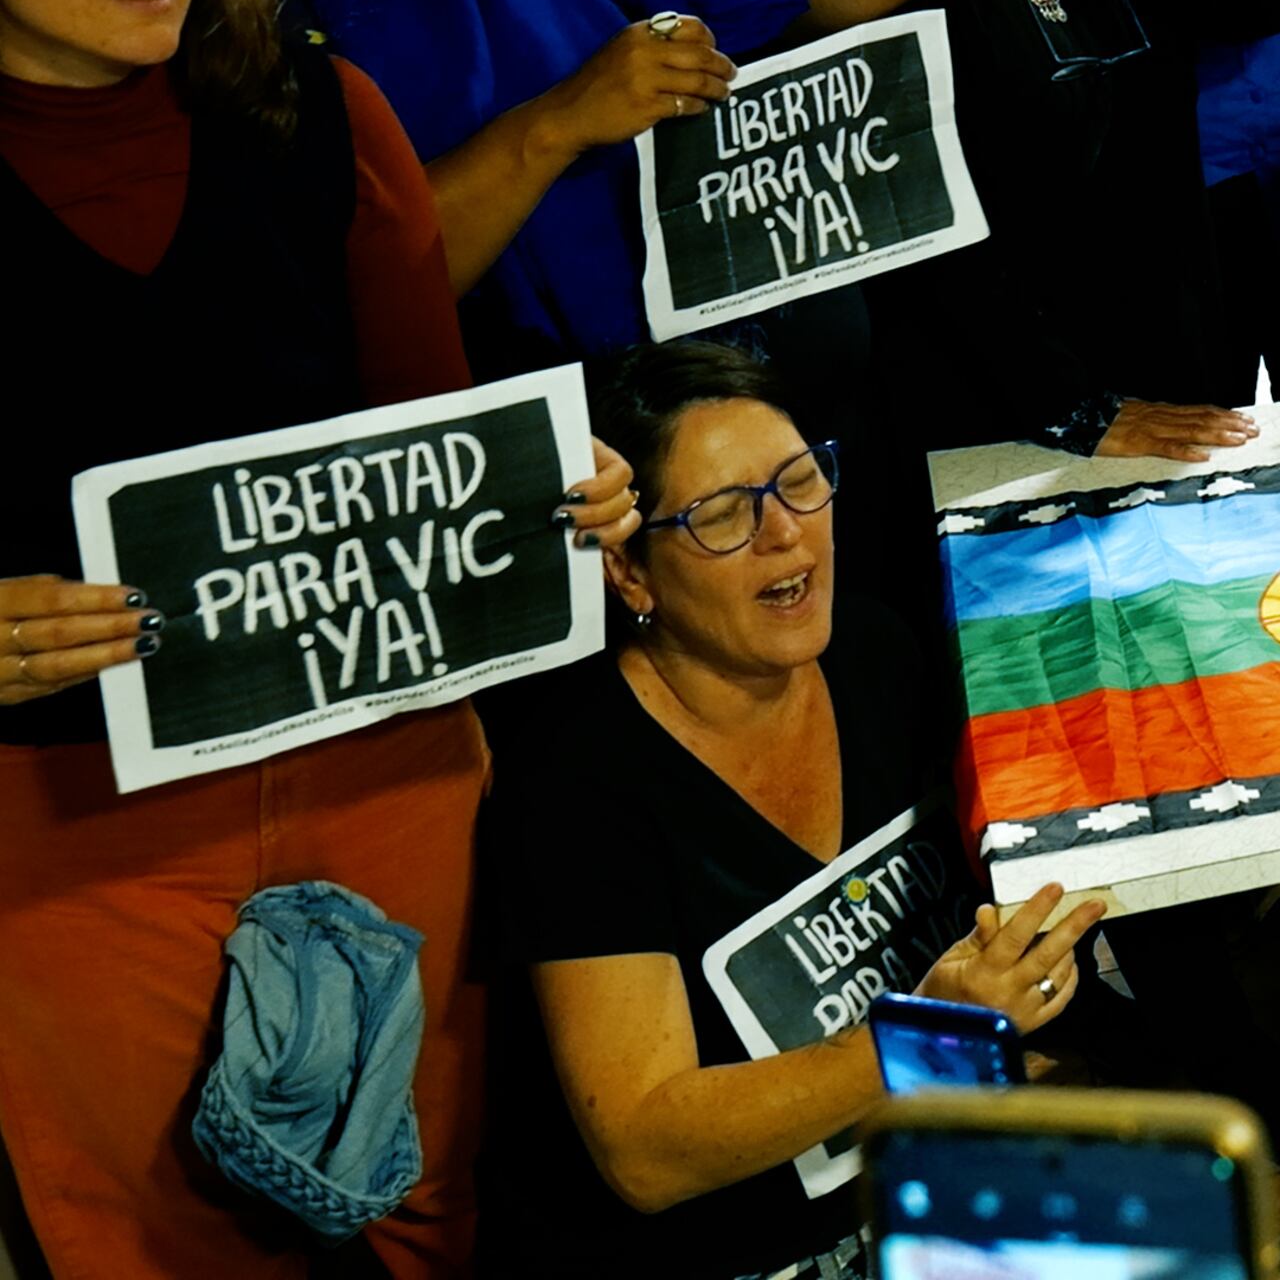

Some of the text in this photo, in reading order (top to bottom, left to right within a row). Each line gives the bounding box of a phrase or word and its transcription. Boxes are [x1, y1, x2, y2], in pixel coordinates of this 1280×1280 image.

[714, 57, 874, 161] LIBERTAD
[697, 117, 900, 224] PARA VIC
[762, 183, 870, 280] ¡YA!
[211, 431, 487, 554] LIBERTAD
[194, 509, 515, 641] PARA VIC
[296, 591, 449, 712] ¡YA!
